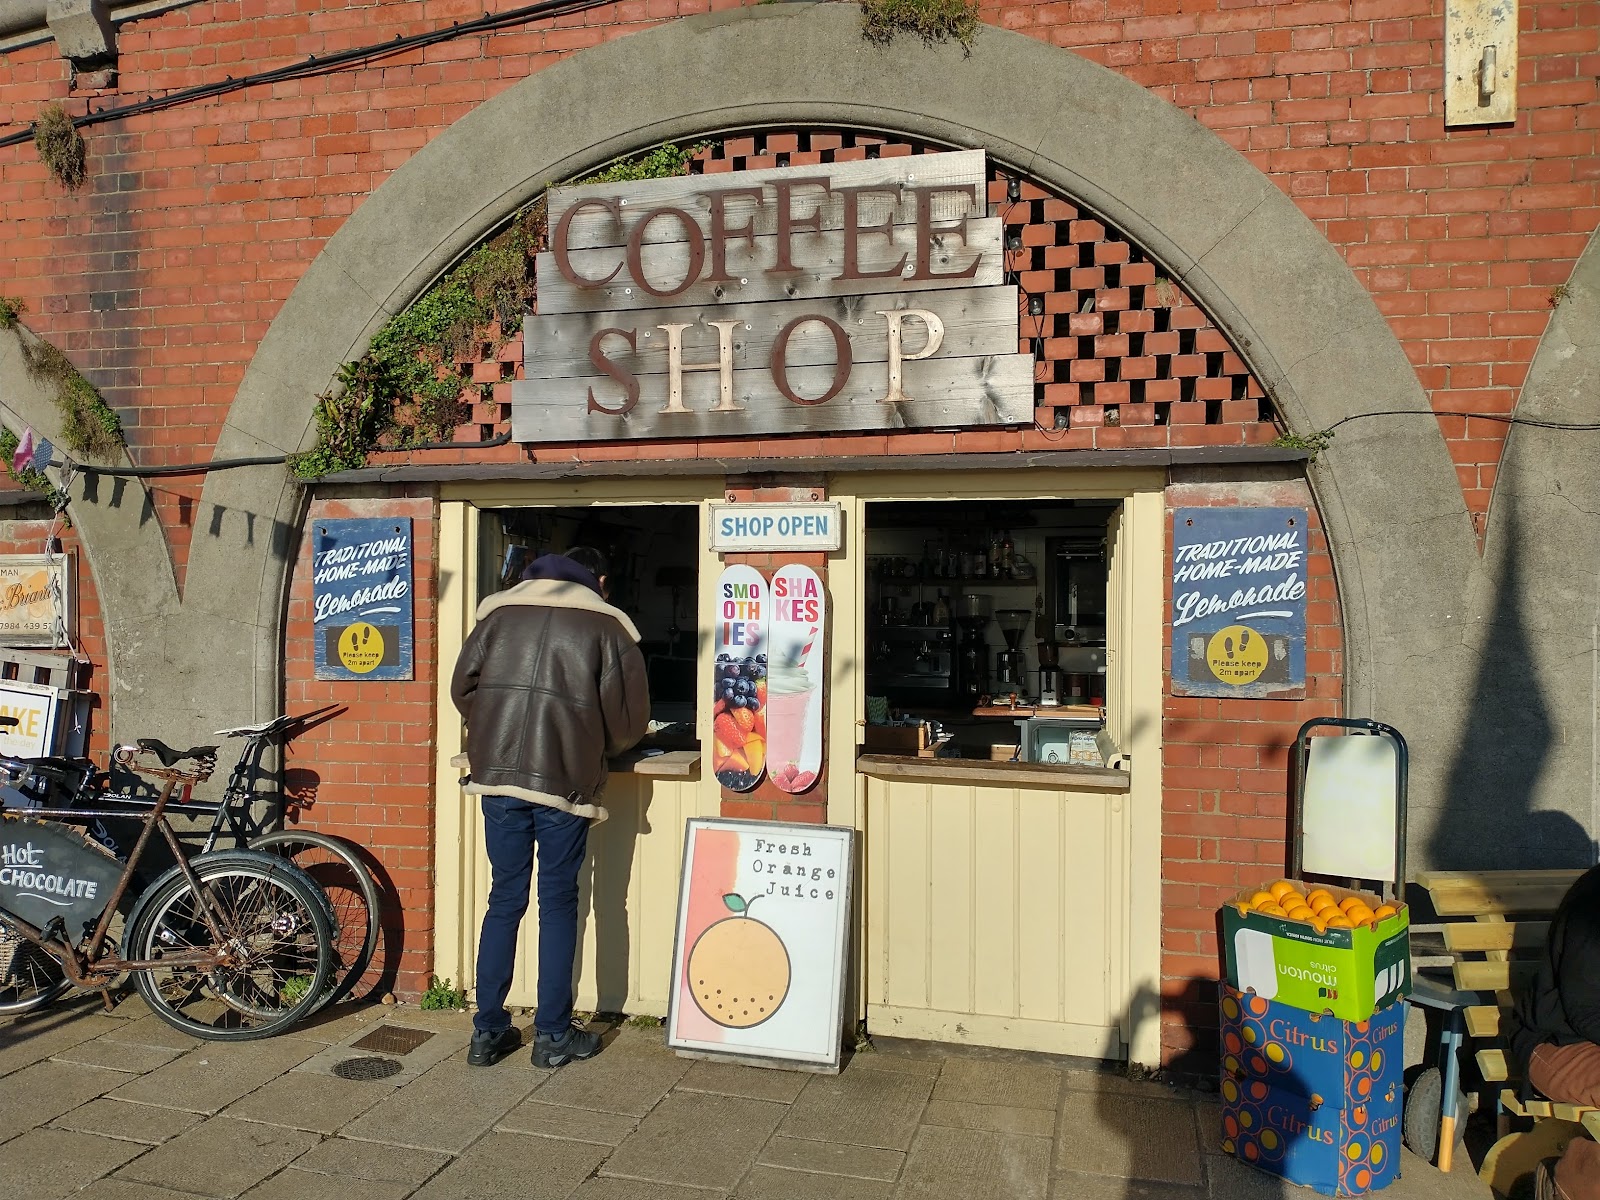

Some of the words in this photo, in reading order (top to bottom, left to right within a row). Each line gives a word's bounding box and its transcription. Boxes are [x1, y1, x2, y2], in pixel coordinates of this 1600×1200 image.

[553, 177, 982, 296] COFFEE
[587, 308, 945, 415] SHOP
[720, 516, 774, 537] SHOP
[777, 515, 829, 536] OPEN
[314, 536, 407, 568] TRADITIONAL
[1175, 530, 1300, 563] TRADITIONAL
[314, 552, 408, 585] HOME-MADE
[1173, 550, 1303, 583] HOME-MADE
[314, 574, 409, 624] Lemonade
[723, 583, 760, 599] SMO
[775, 577, 819, 598] SHA
[1173, 572, 1306, 627] Lemonade
[723, 600, 760, 620] OTH
[775, 599, 819, 623] KES
[24, 622, 41, 630] 439
[723, 622, 760, 647] IES
[342, 651, 363, 659] Please
[364, 651, 379, 660] keep
[358, 659, 375, 667] apart
[1212, 659, 1239, 668] Please
[1241, 659, 1261, 669] keep
[1234, 669, 1255, 678] apart
[1, 841, 45, 865] Hot
[754, 838, 812, 857] Fresh
[752, 859, 836, 881] Orange
[0, 868, 98, 900] CHOCOLATE
[766, 881, 835, 900] Juice
[1278, 963, 1337, 987] mouton
[1310, 961, 1337, 973] citrus
[1269, 1018, 1338, 1054] Citrus
[1371, 1021, 1398, 1045] Citrus
[1267, 1104, 1333, 1146] Citrus
[1370, 1111, 1398, 1136] Citrus
